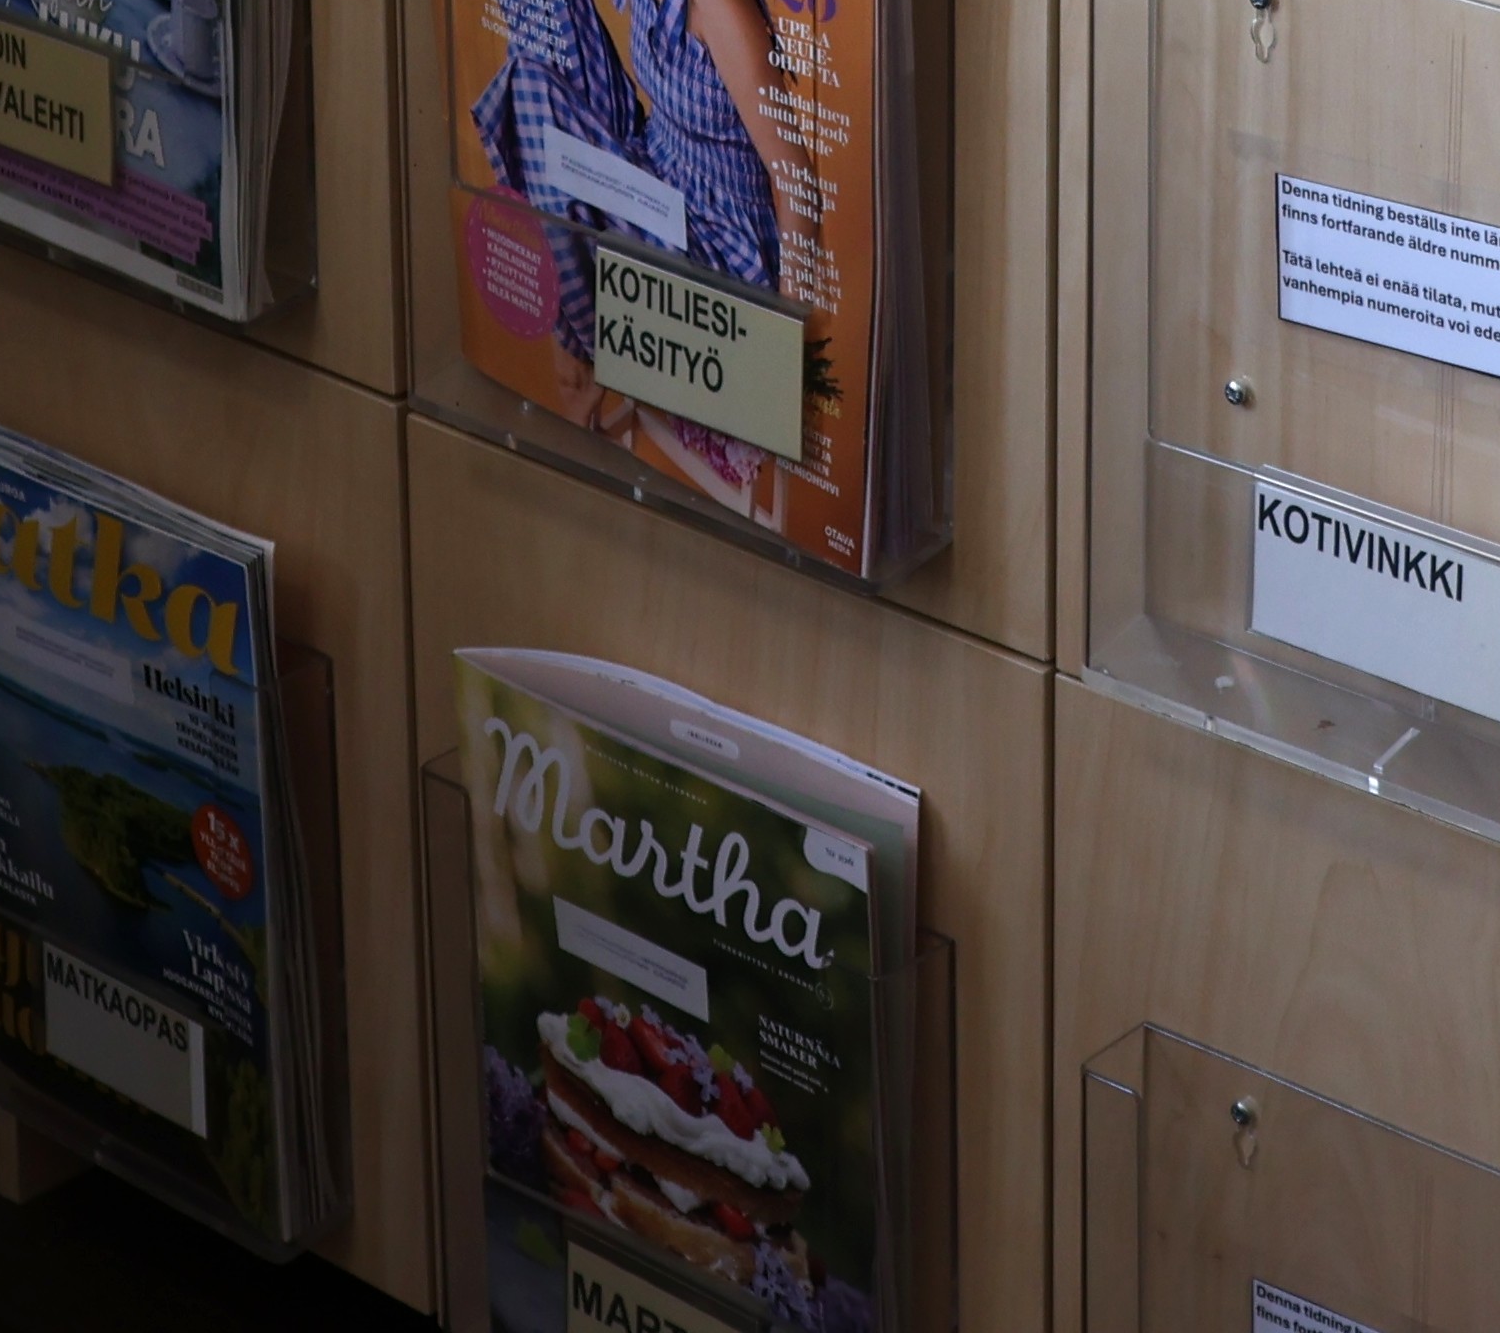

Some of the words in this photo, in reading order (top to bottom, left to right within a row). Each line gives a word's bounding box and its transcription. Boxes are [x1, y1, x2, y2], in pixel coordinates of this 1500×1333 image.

[599, 258, 747, 341] KOTILIESI-
[598, 315, 724, 394] KÄSITYÖ
[1257, 493, 1464, 602] KOTIVINKKI
[484, 717, 833, 970] Martha
[45, 950, 191, 1054] MATKAOPAS
